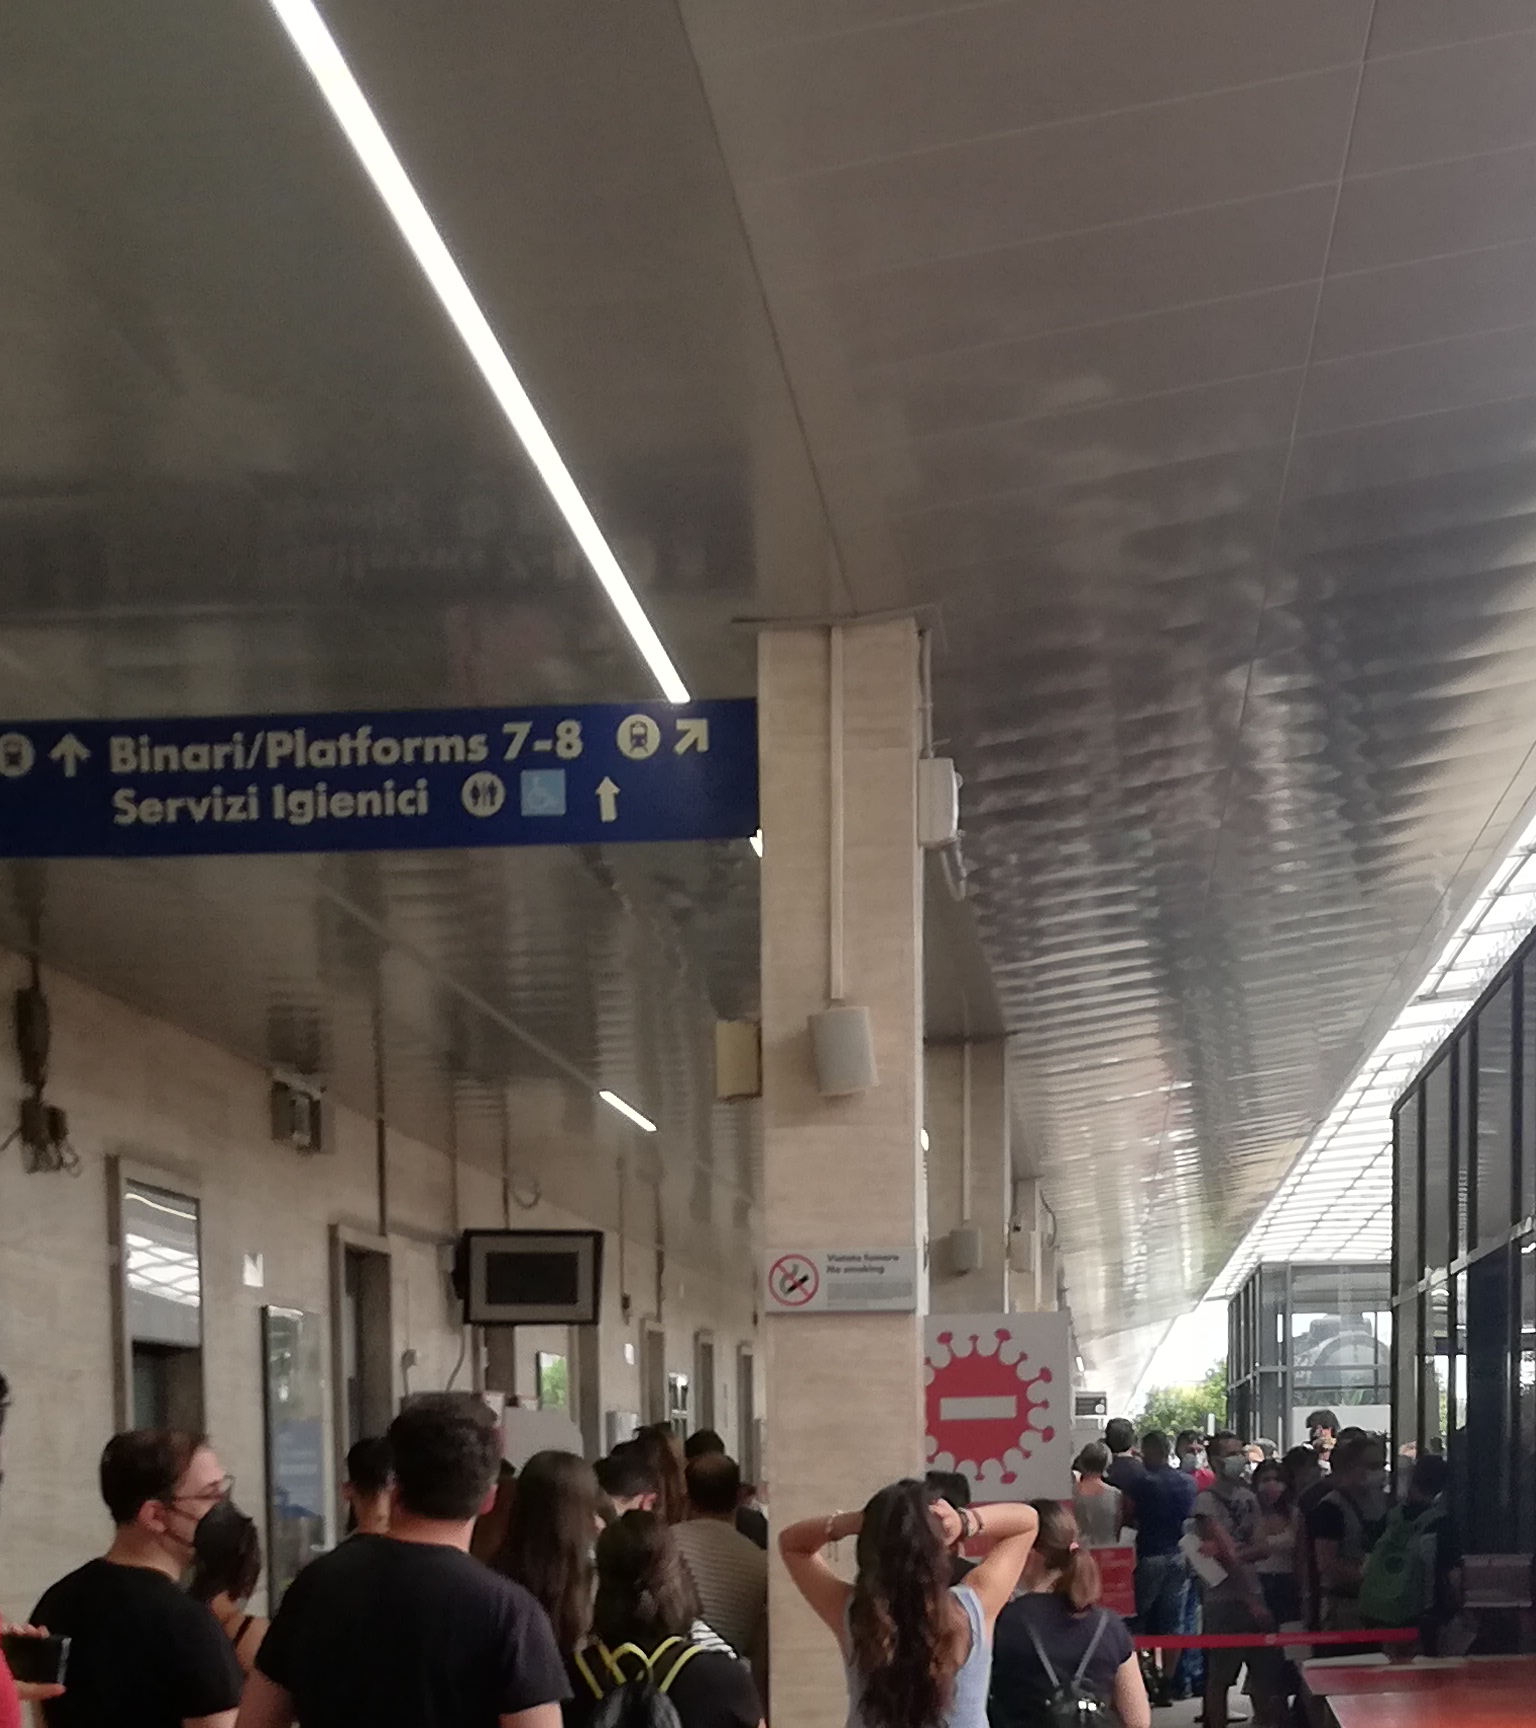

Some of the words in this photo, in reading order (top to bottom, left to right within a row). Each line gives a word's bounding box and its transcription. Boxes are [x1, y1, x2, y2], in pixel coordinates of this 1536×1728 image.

[109, 726, 489, 774] Binari/Platforms
[501, 720, 584, 761] 7-8
[112, 783, 260, 826] Servizi
[272, 778, 430, 827] Igienici
